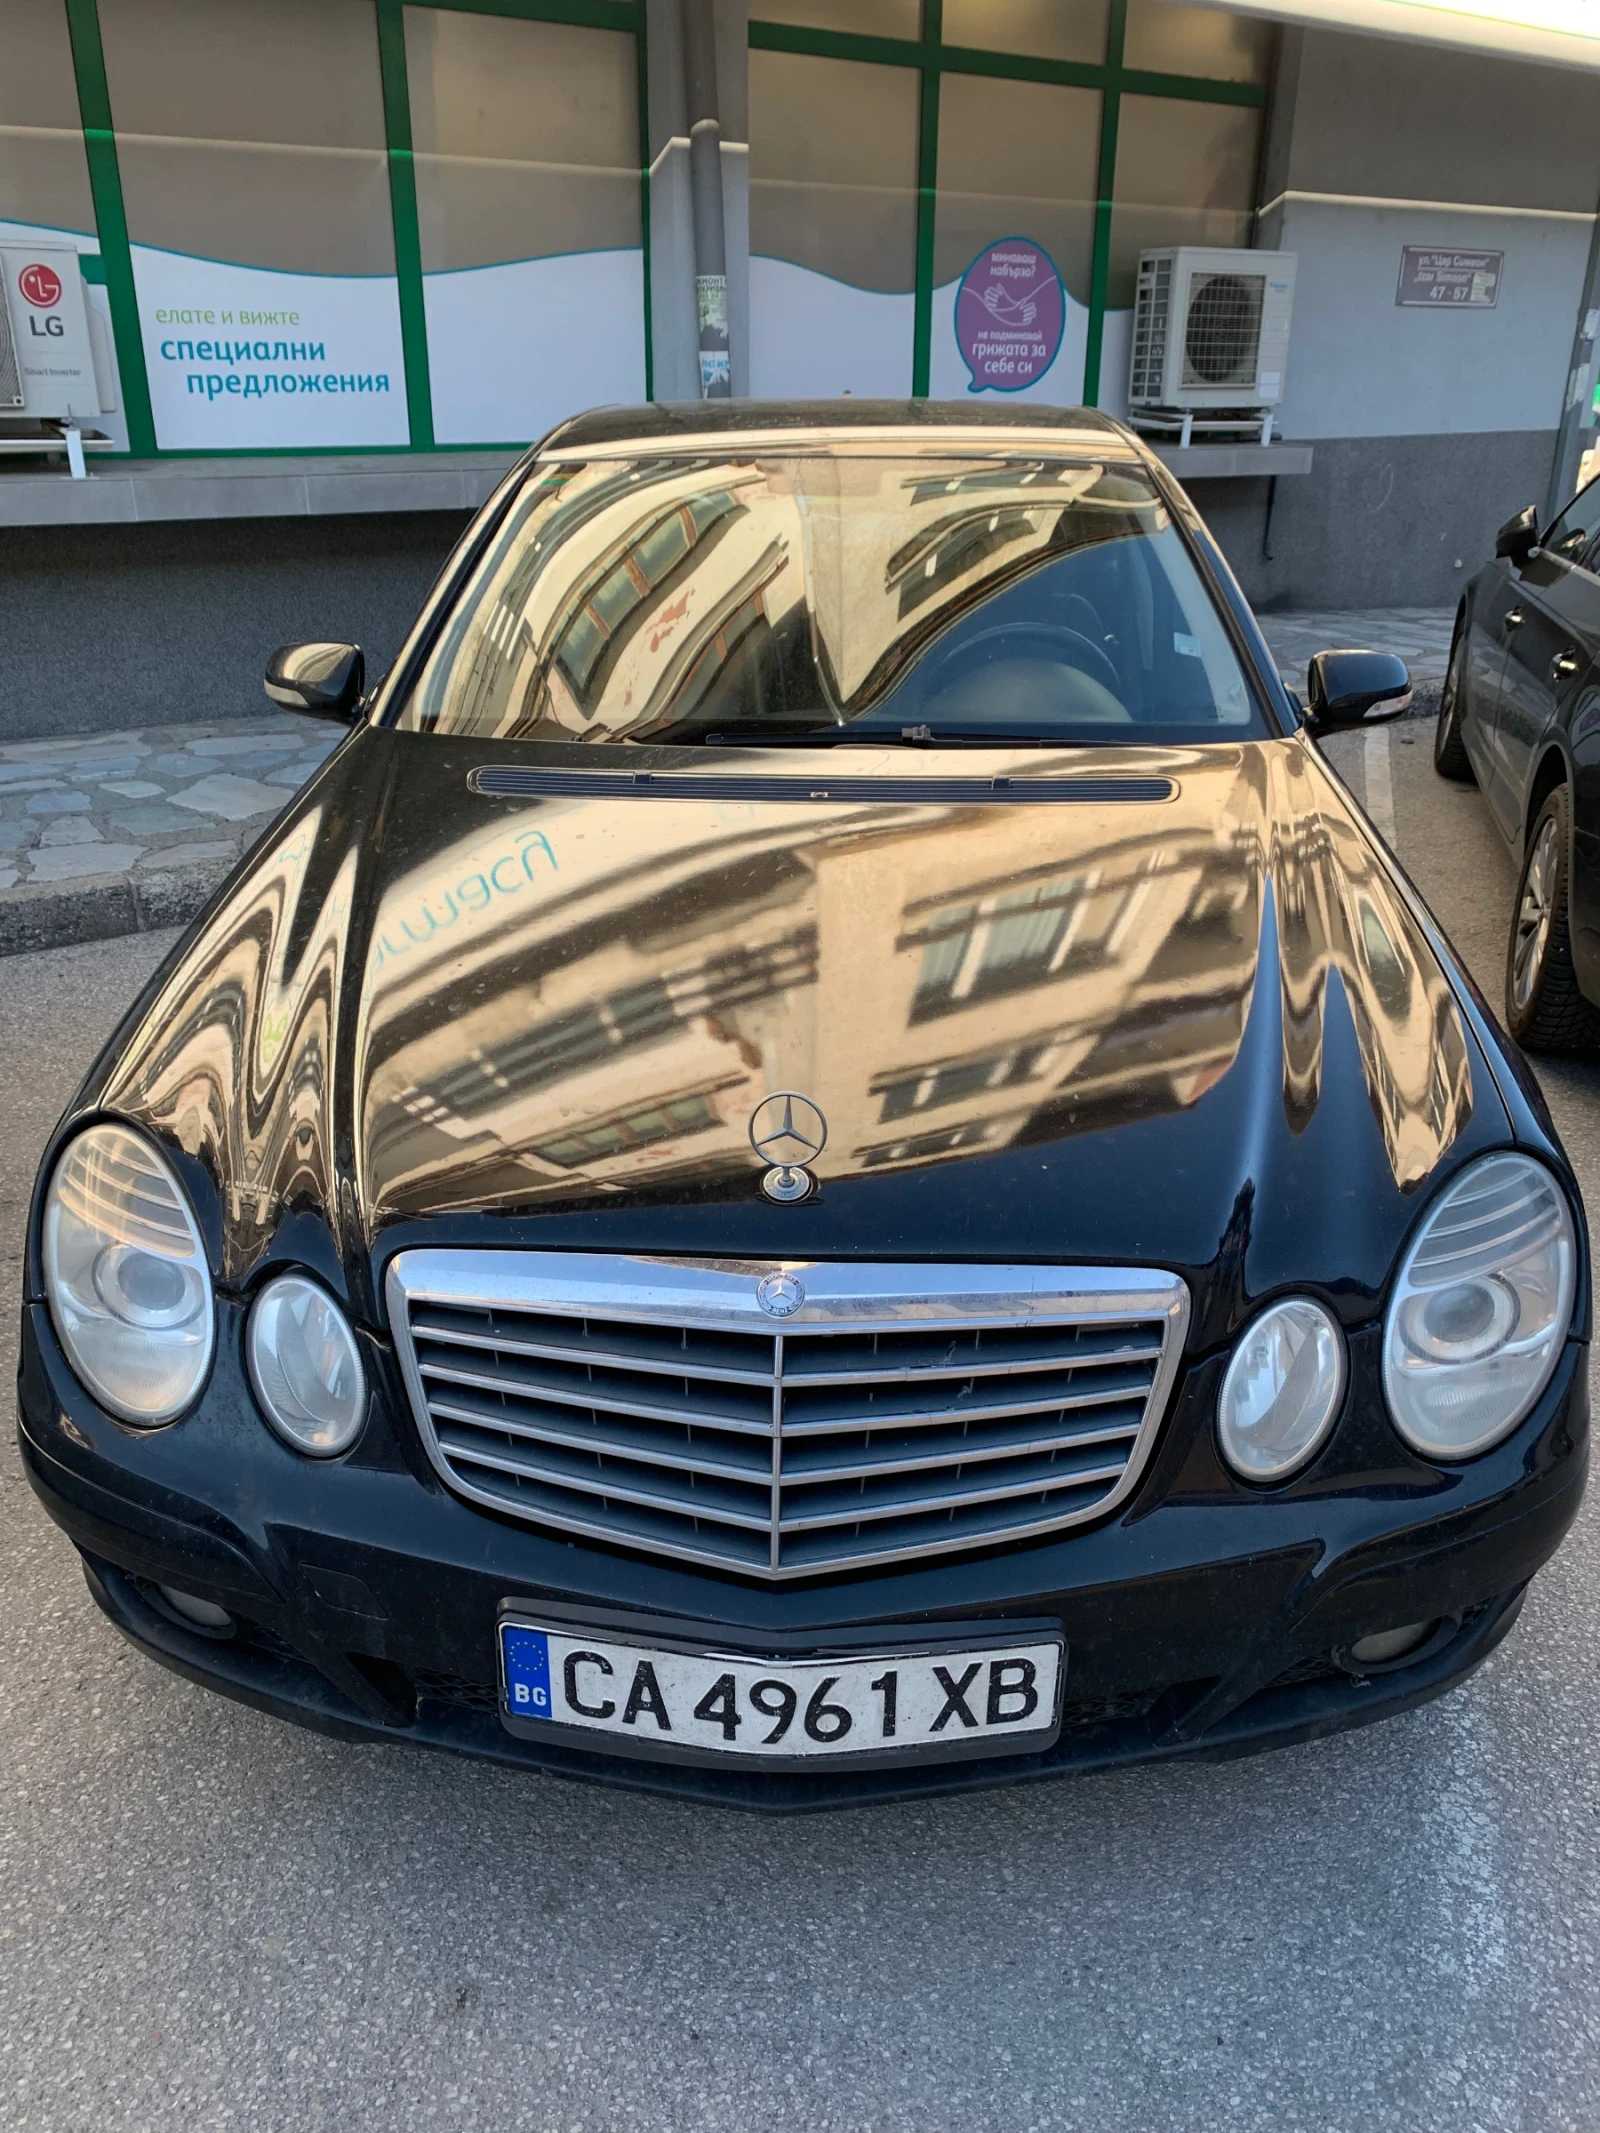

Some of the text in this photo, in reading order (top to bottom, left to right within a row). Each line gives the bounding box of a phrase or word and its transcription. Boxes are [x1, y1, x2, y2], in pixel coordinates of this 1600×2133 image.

[989, 264, 1036, 279] набързо?
[1429, 285, 1446, 299] 47
[156, 309, 300, 325] елате и вижте
[29, 315, 64, 337] LG
[977, 331, 988, 340] не
[160, 339, 325, 365] специални
[972, 343, 1046, 359] грижата за
[984, 356, 1032, 374] себе си
[186, 372, 390, 401] предложения
[514, 1650, 1039, 1744] BG CA 4961 XB
